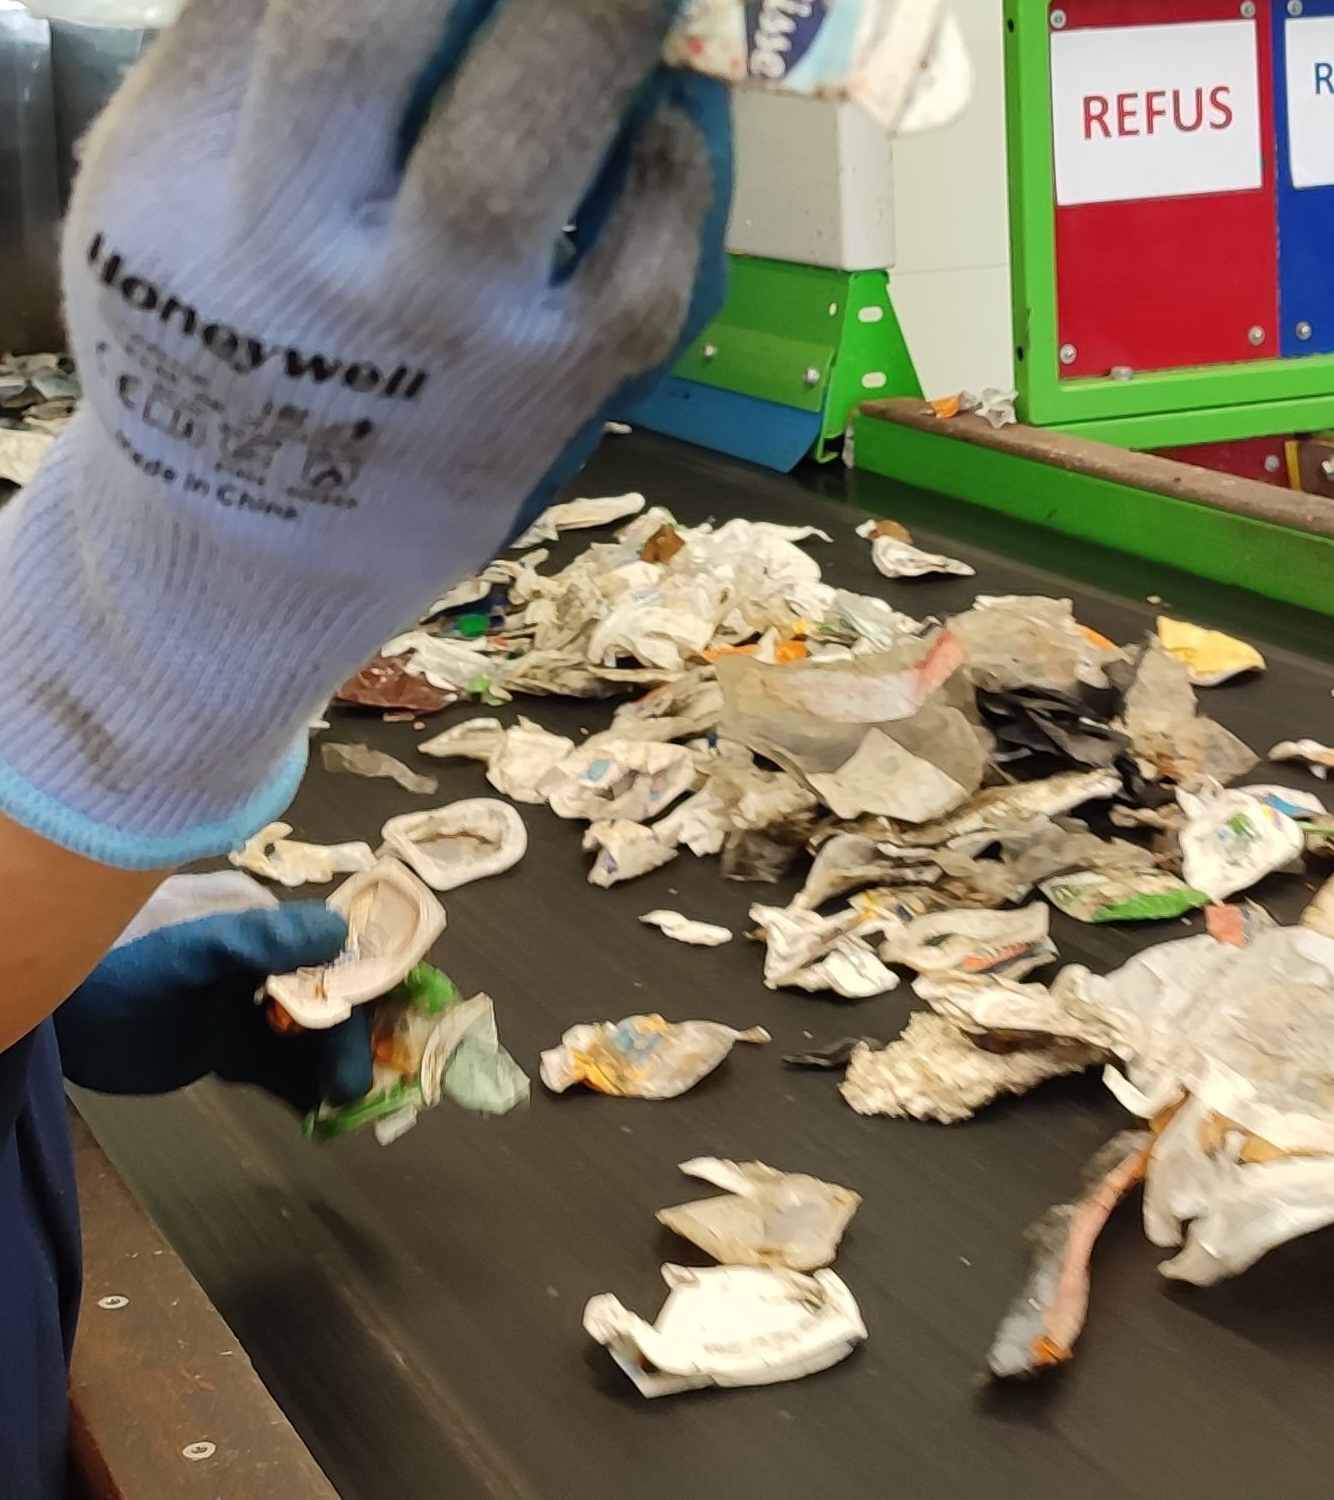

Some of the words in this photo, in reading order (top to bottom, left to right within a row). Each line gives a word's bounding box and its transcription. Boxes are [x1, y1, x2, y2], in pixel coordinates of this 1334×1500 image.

[1081, 85, 1234, 141] REFUS
[86, 232, 428, 399] Honeywell
[216, 485, 298, 520] China
